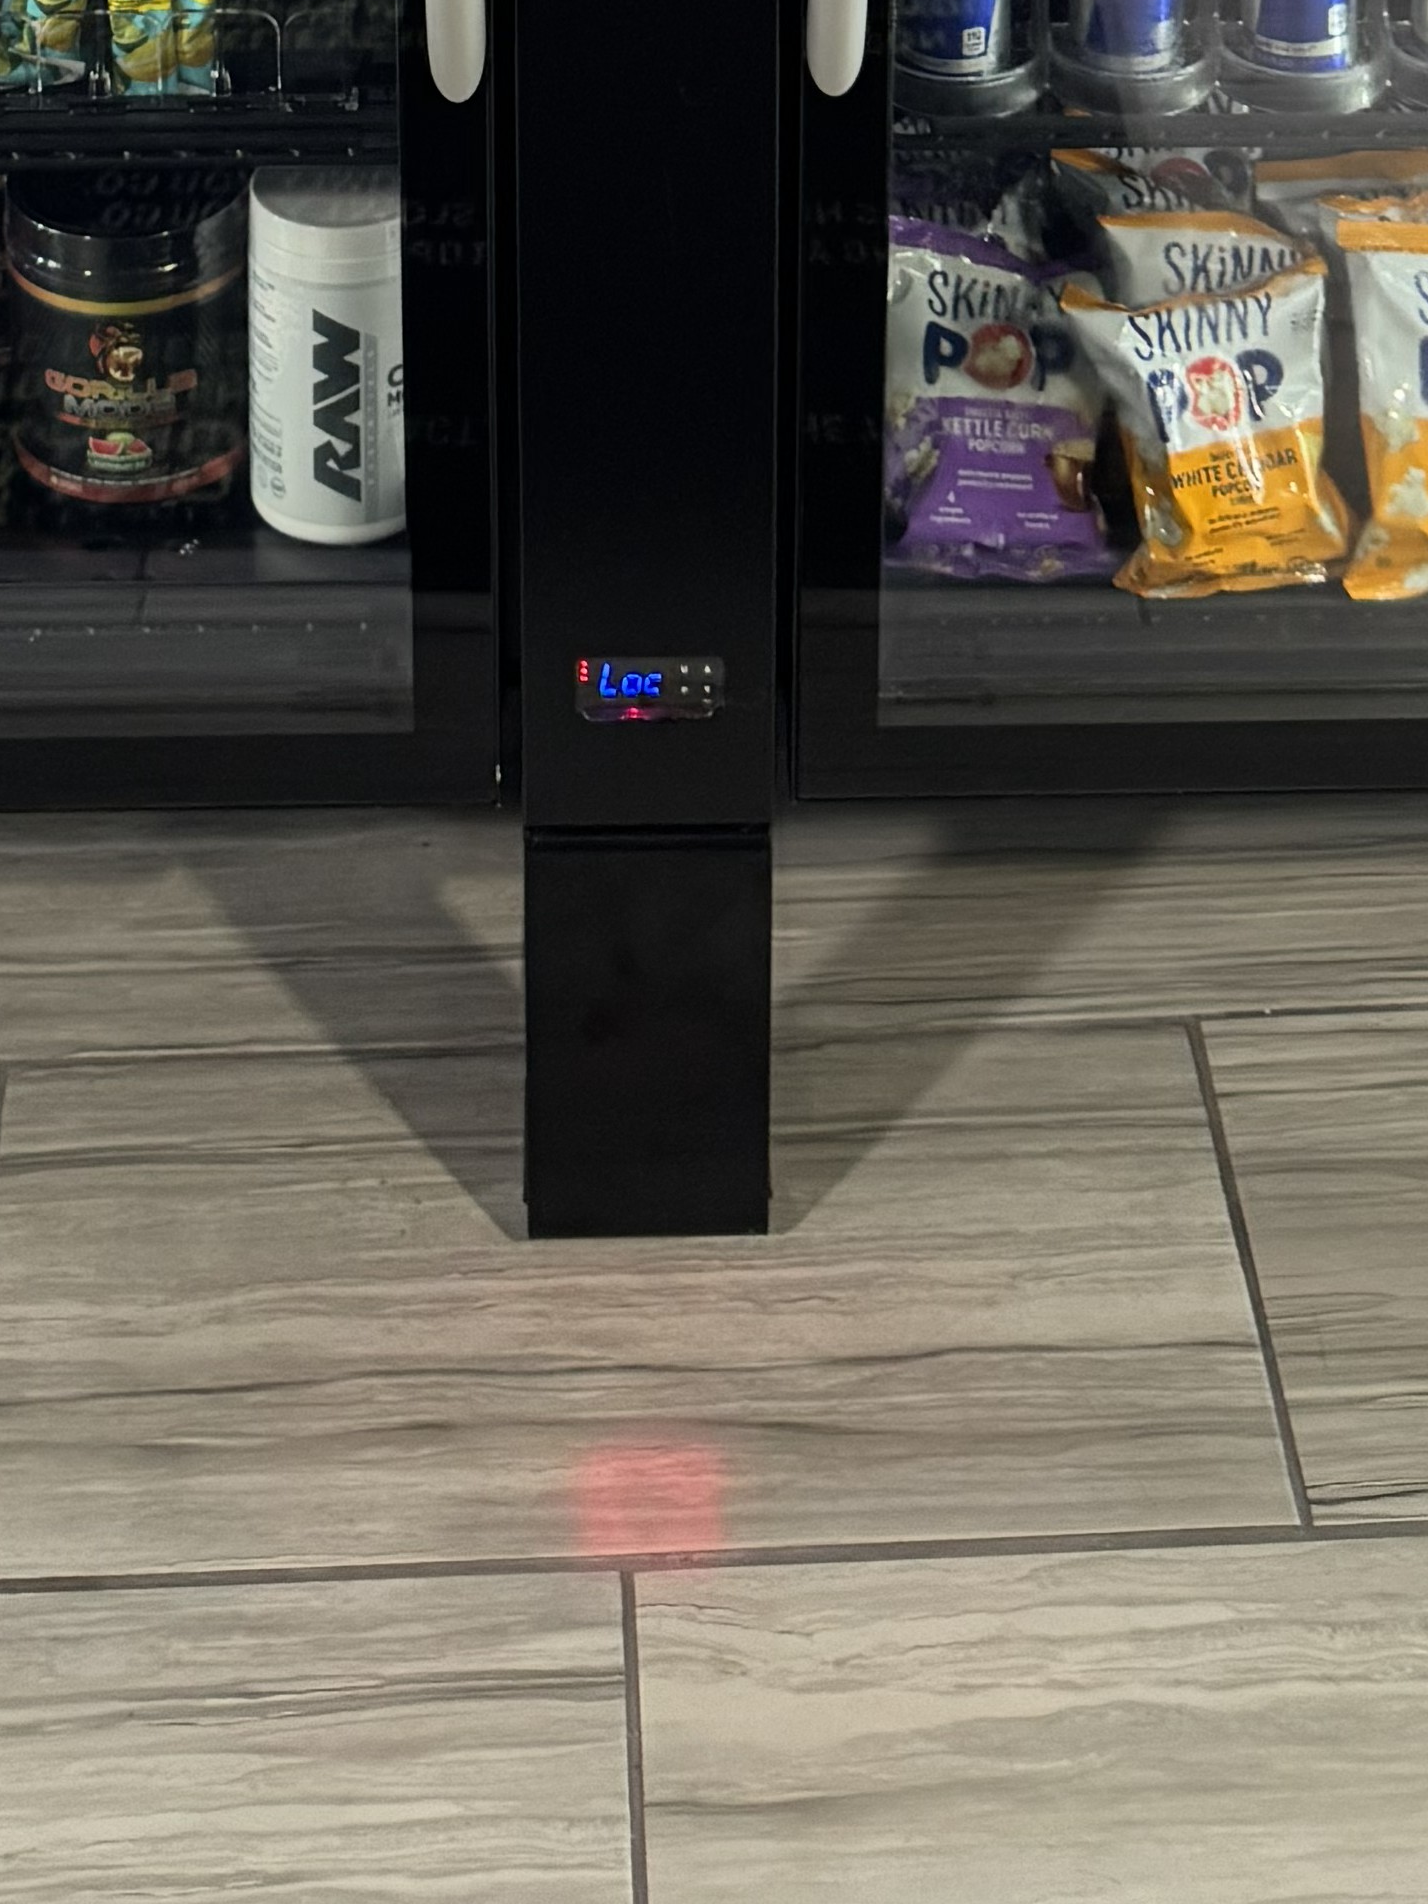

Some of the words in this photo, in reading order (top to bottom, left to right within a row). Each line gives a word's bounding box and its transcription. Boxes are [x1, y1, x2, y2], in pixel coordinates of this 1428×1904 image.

[923, 320, 1070, 391] POP
[1146, 348, 1284, 443] POP
[312, 308, 362, 504] RAW
[1172, 464, 1221, 490] WHITE
